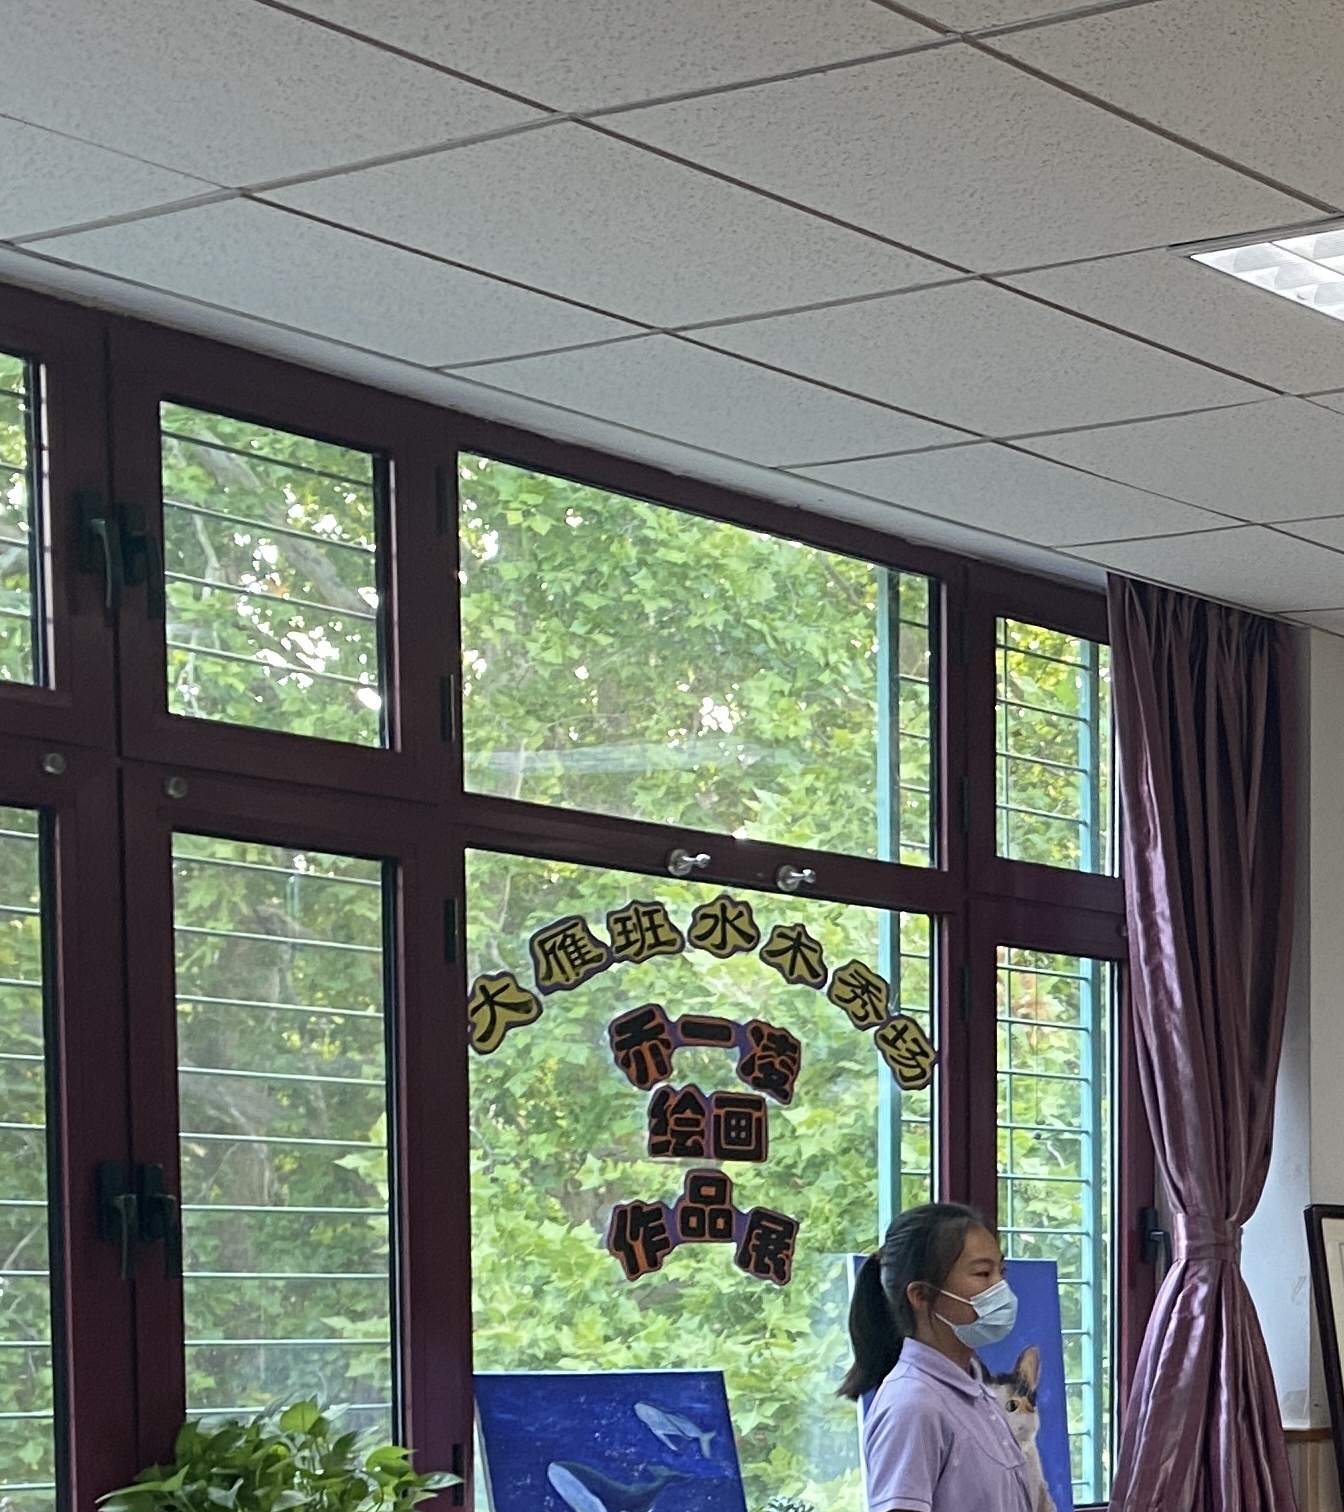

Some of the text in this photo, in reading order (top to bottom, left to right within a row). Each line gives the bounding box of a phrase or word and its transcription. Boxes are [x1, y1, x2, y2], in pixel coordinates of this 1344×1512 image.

[469, 902, 932, 1085] 大雁班水木秀场
[649, 1088, 766, 1161] 绘画
[613, 1174, 797, 1282] 作品展
